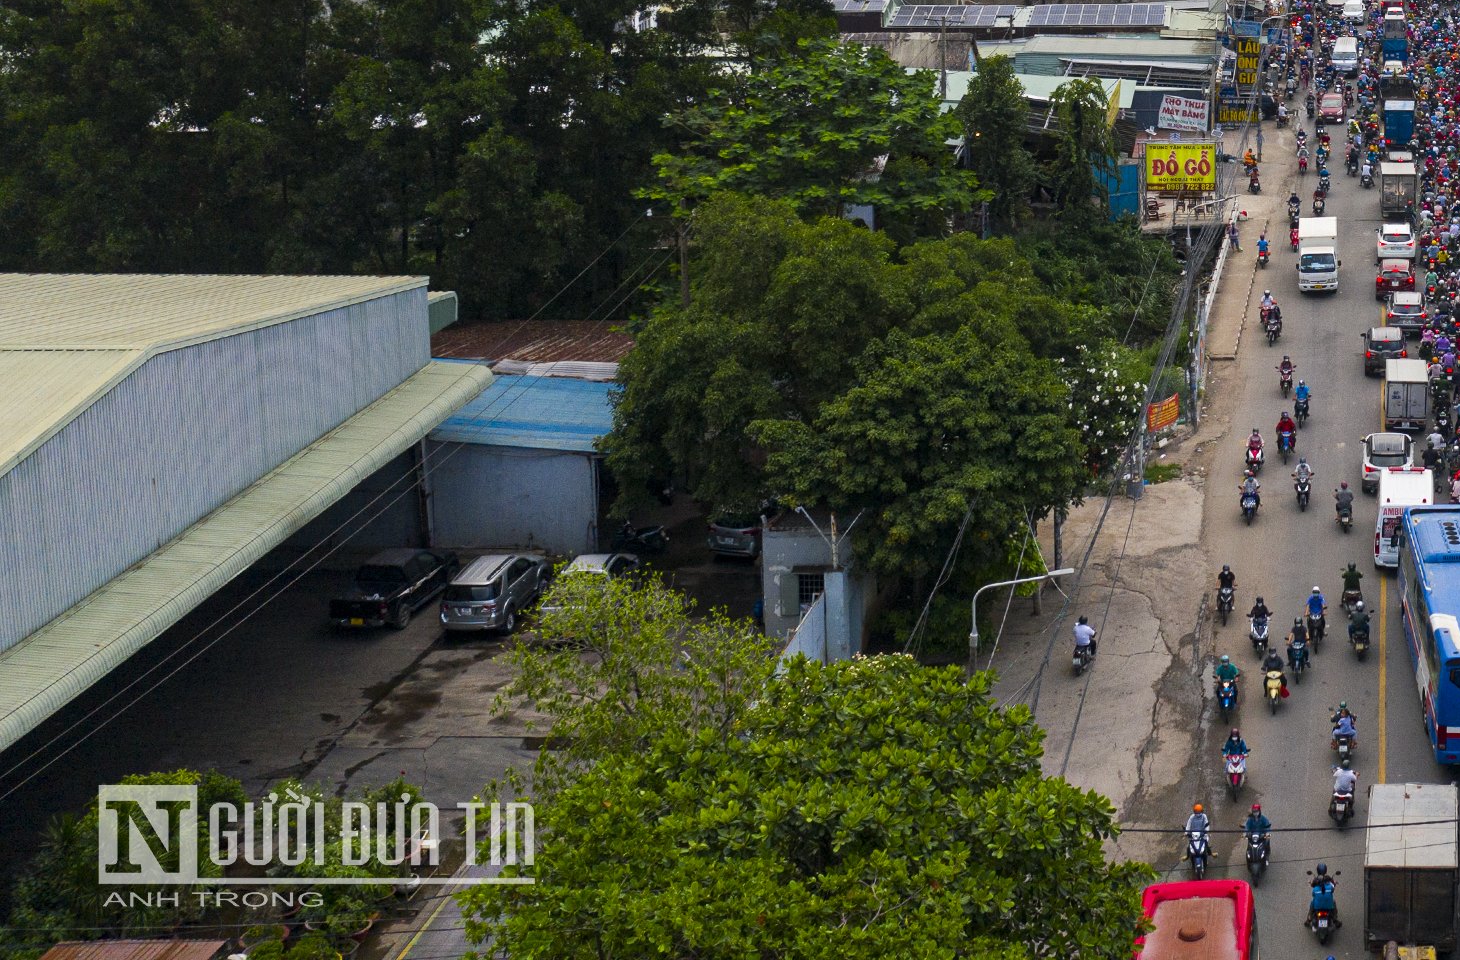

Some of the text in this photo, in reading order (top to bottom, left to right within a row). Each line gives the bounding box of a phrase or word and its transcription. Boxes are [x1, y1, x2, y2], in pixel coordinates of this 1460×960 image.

[1165, 98, 1181, 107] CHO
[1152, 150, 1211, 176] ĐỒ GỖ
[1186, 183, 1200, 191] 722
[1201, 183, 1214, 191] 822
